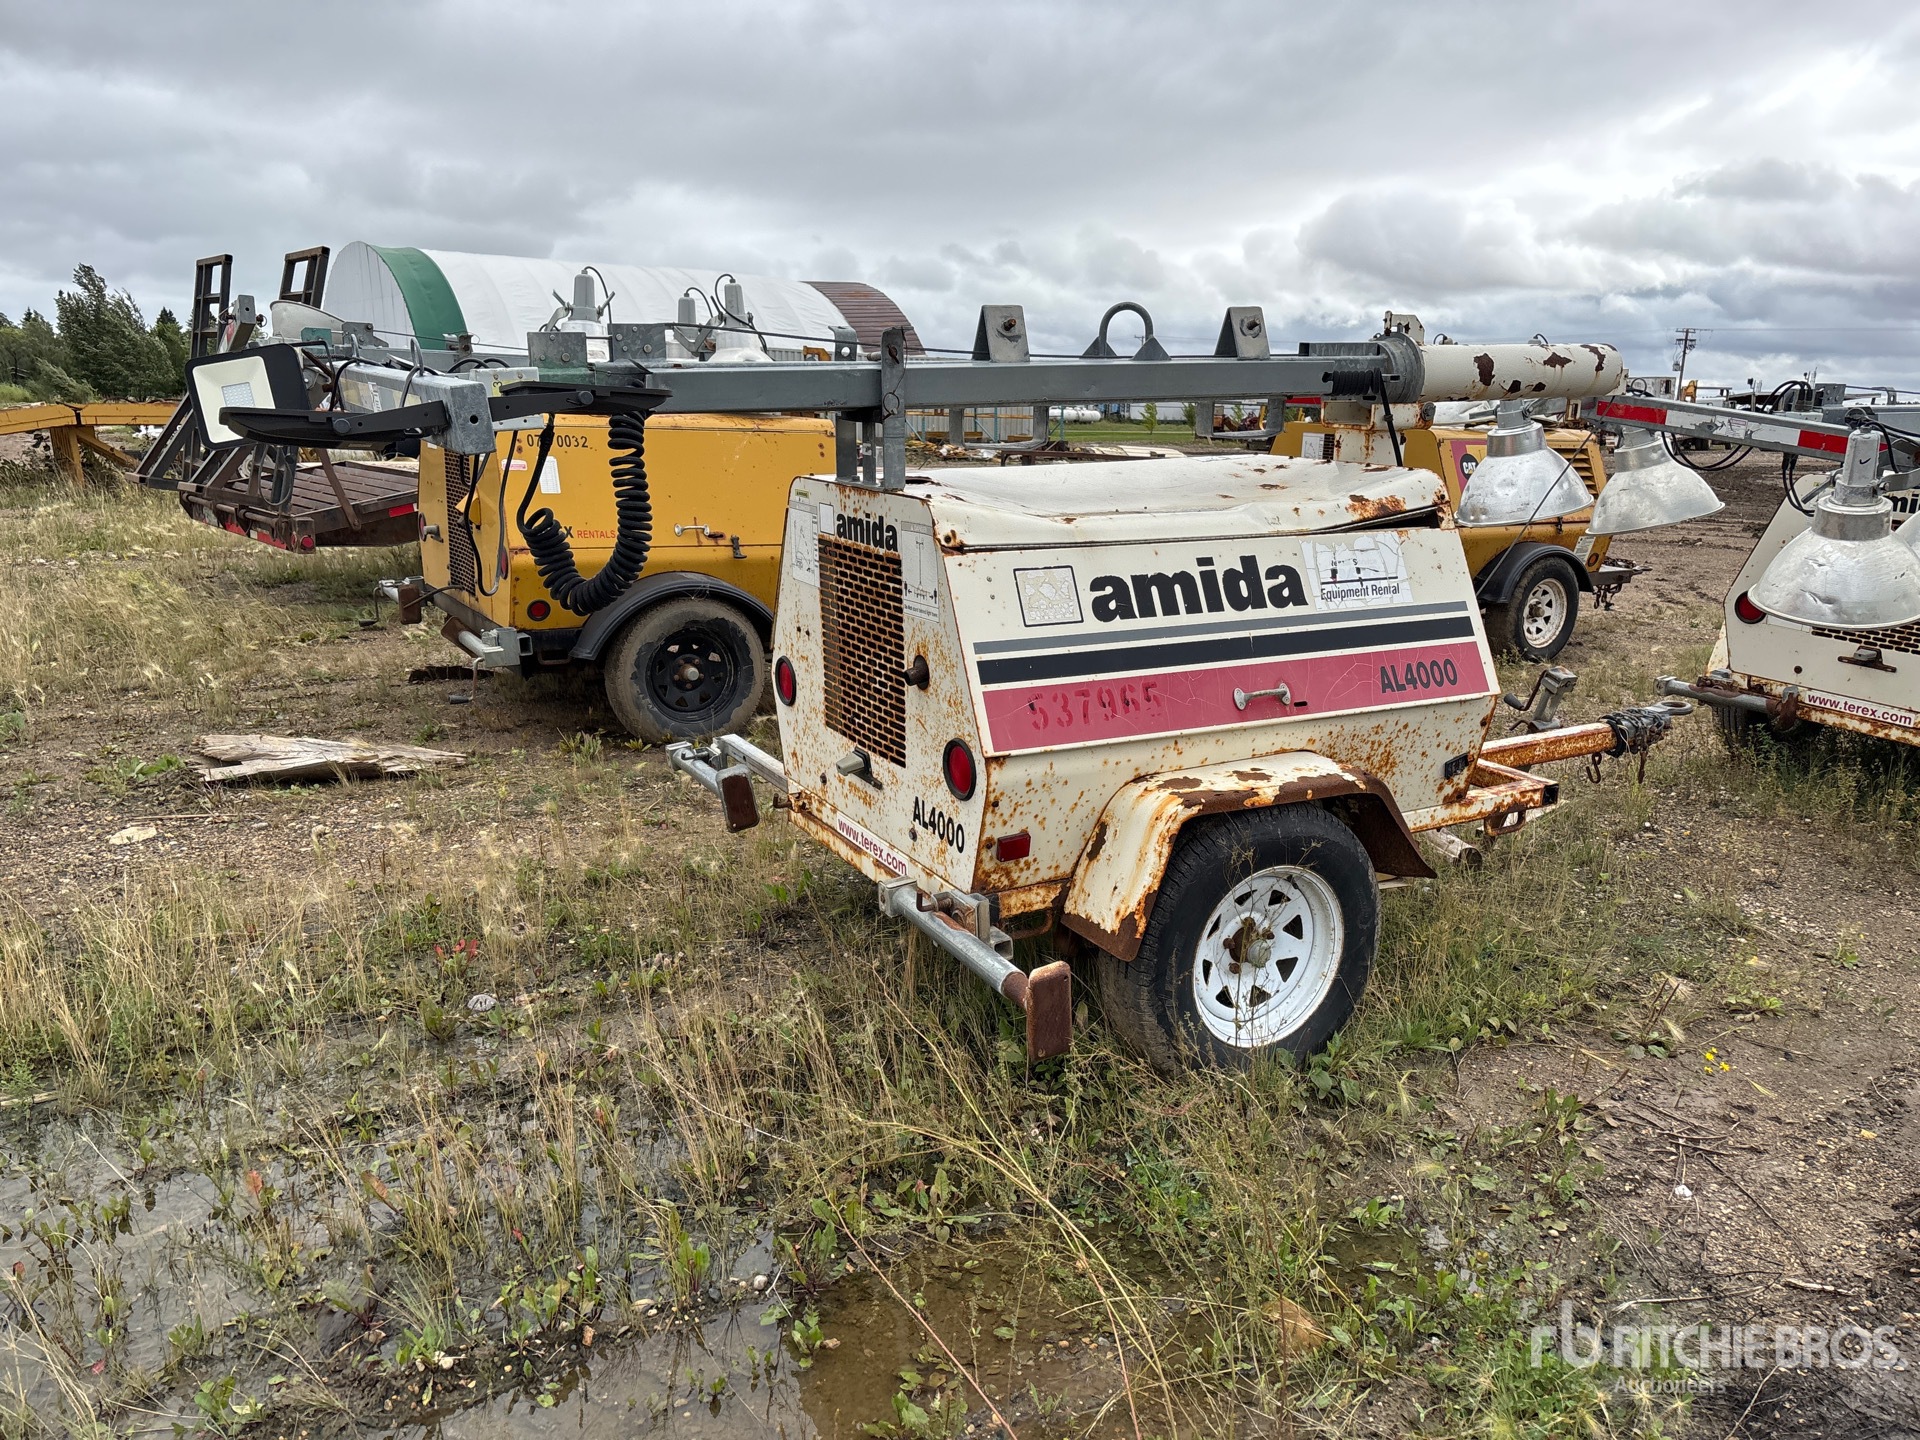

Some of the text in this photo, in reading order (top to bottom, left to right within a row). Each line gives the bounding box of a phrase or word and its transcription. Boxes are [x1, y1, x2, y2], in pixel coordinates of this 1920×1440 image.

[1462, 461, 1477, 475] CAT
[577, 530, 616, 539] RENTALS
[837, 512, 898, 552] amida
[1090, 555, 1308, 622] amida
[1320, 583, 1400, 602] Equipment Rental
[1380, 658, 1458, 693] AL4000
[1808, 694, 1912, 725] www.terex.com
[913, 796, 965, 853] AL4000
[838, 819, 907, 876] www.terex.com
